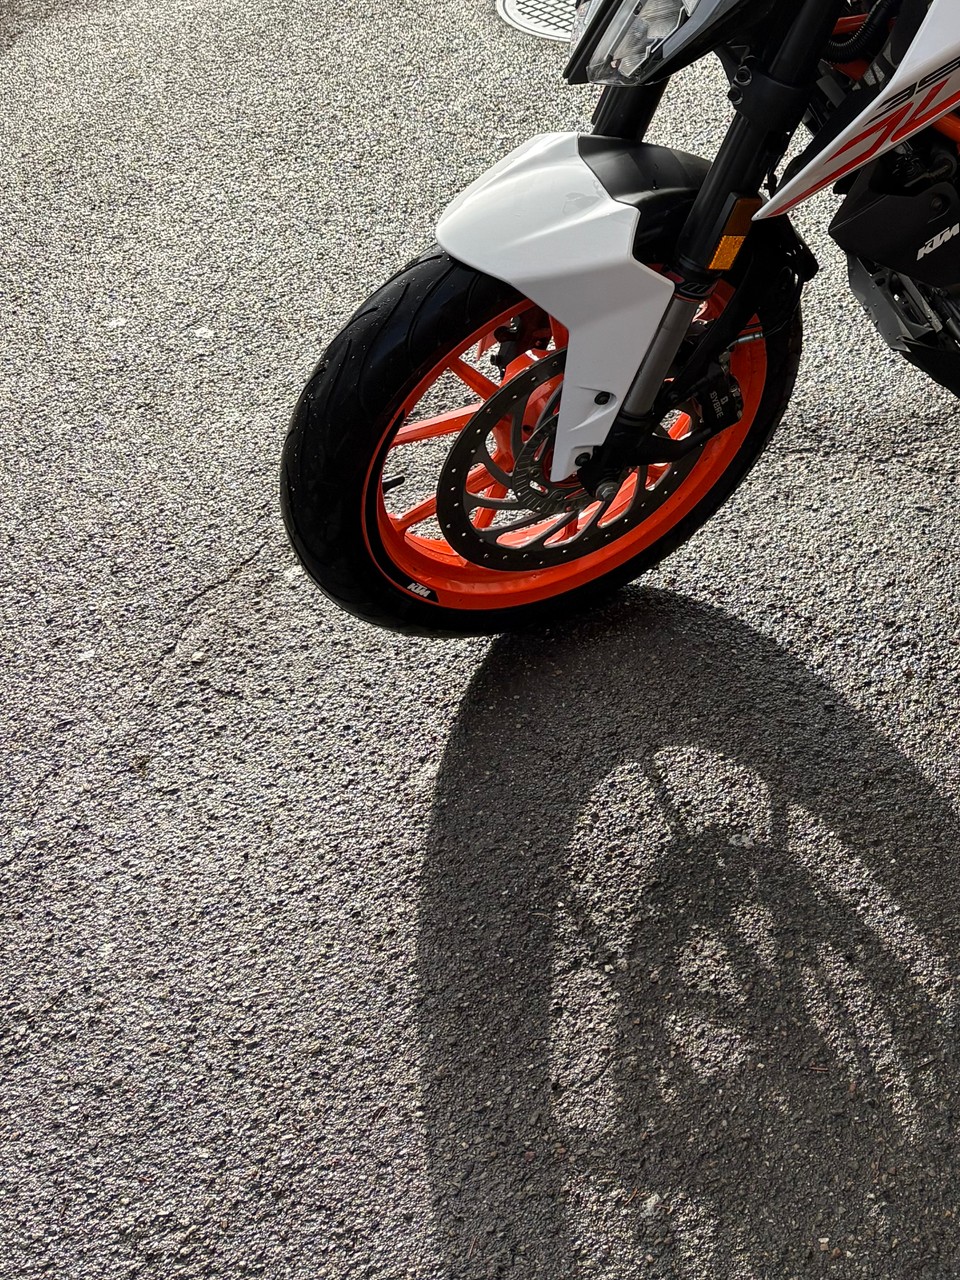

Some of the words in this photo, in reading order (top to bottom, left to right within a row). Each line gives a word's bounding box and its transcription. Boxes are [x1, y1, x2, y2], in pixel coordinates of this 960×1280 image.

[916, 222, 960, 261] KTM
[710, 391, 725, 419] BYBRE
[406, 582, 431, 598] KTM
